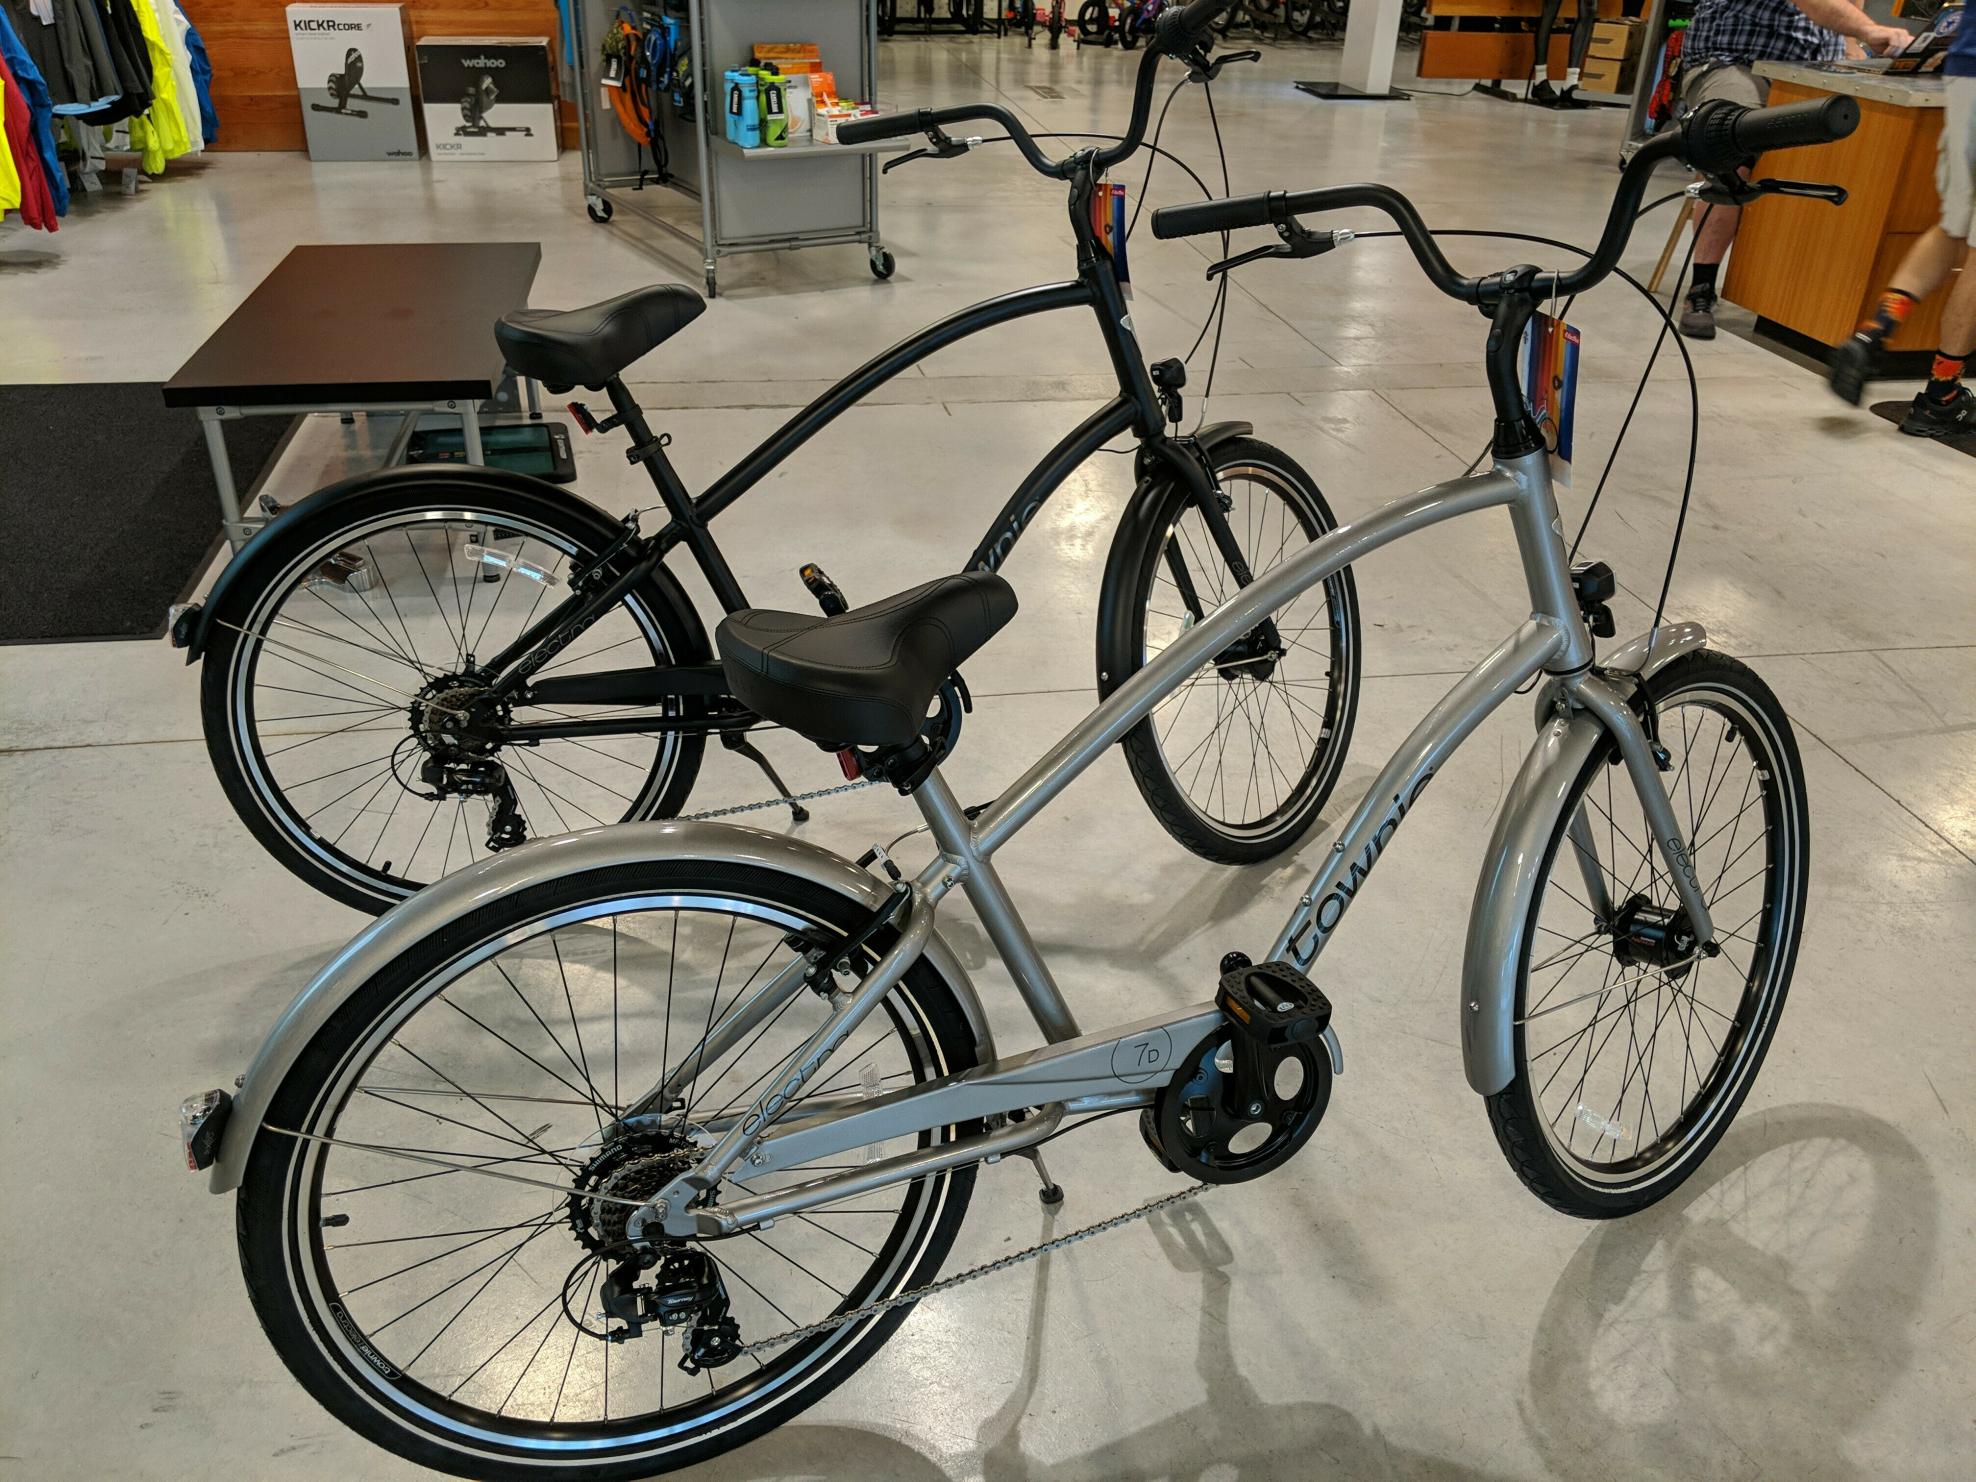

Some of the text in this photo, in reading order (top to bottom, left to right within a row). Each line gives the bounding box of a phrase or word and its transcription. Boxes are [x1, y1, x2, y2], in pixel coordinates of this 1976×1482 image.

[293, 20, 363, 31] KICKR CORE
[461, 54, 506, 68] wahoo
[386, 149, 413, 157] wahoo
[435, 143, 462, 151] KICKR
[1134, 1042, 1160, 1067] 7D
[588, 1144, 623, 1172] SHIMANO
[361, 1344, 391, 1375] townie
